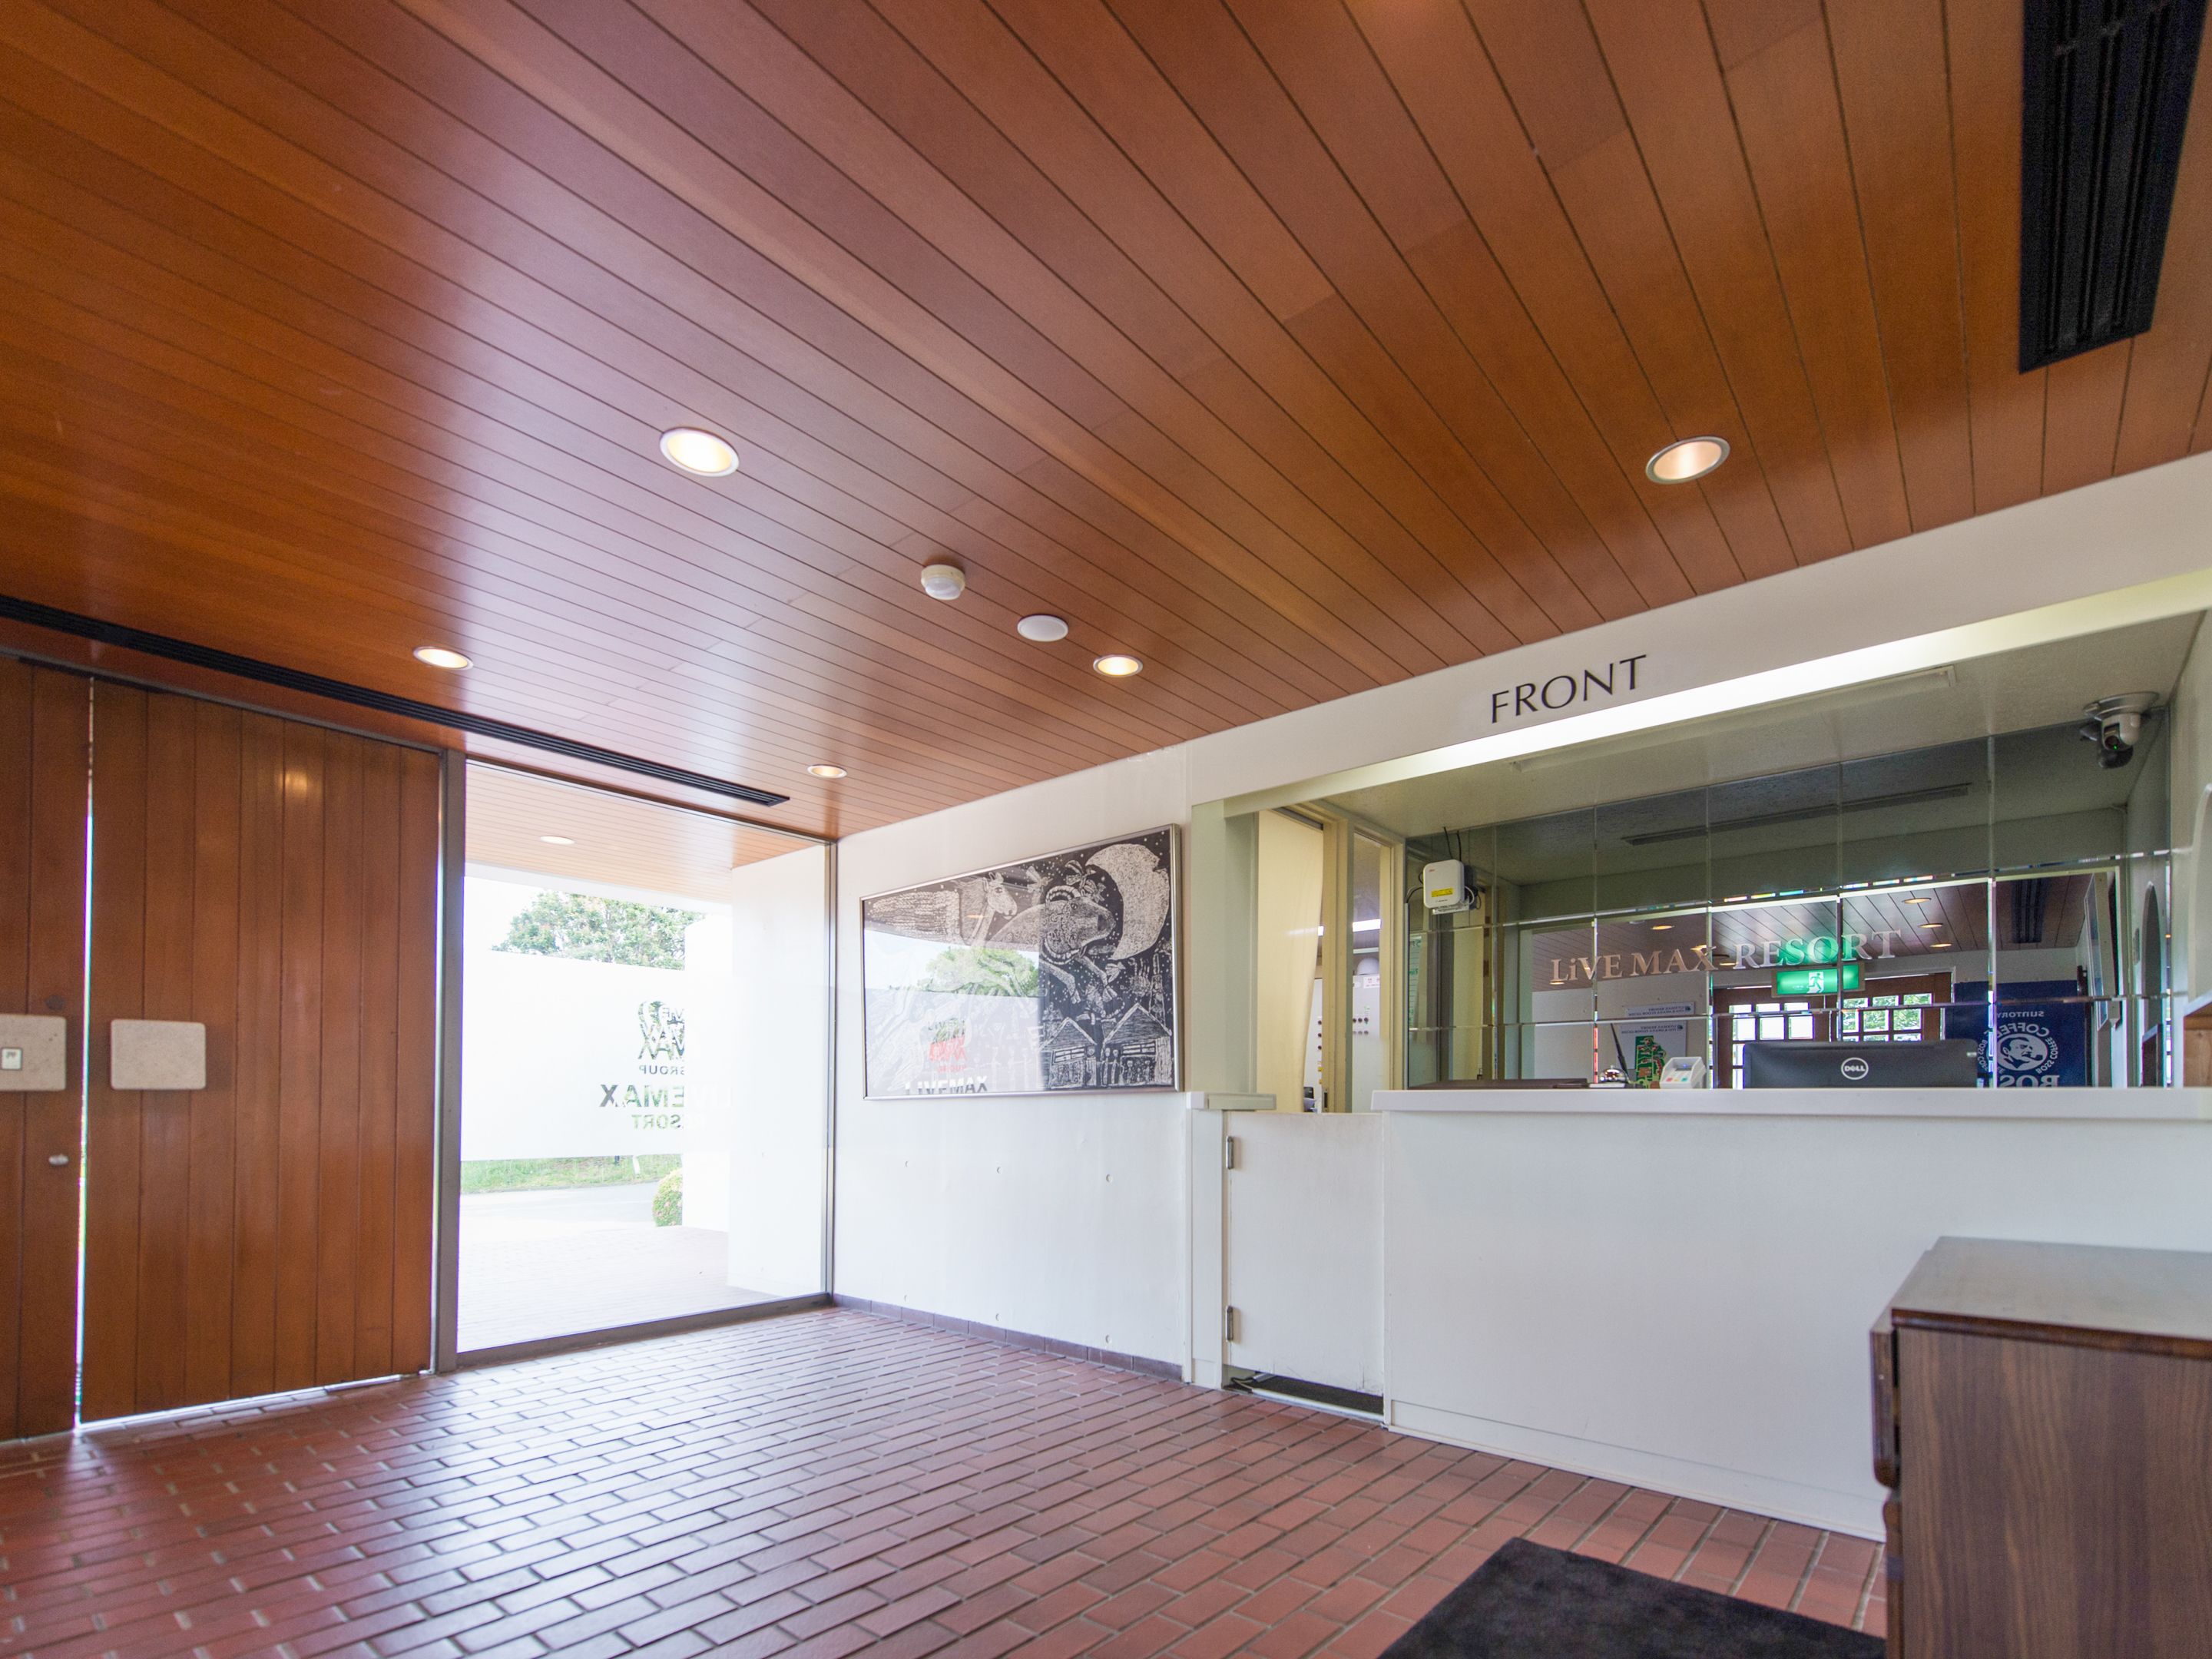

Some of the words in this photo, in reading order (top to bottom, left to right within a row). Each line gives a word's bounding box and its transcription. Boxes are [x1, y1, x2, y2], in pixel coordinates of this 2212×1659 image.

[1492, 654, 1647, 724] FRONT
[1630, 945, 1718, 976] MAX
[1733, 929, 1902, 969] RESORT
